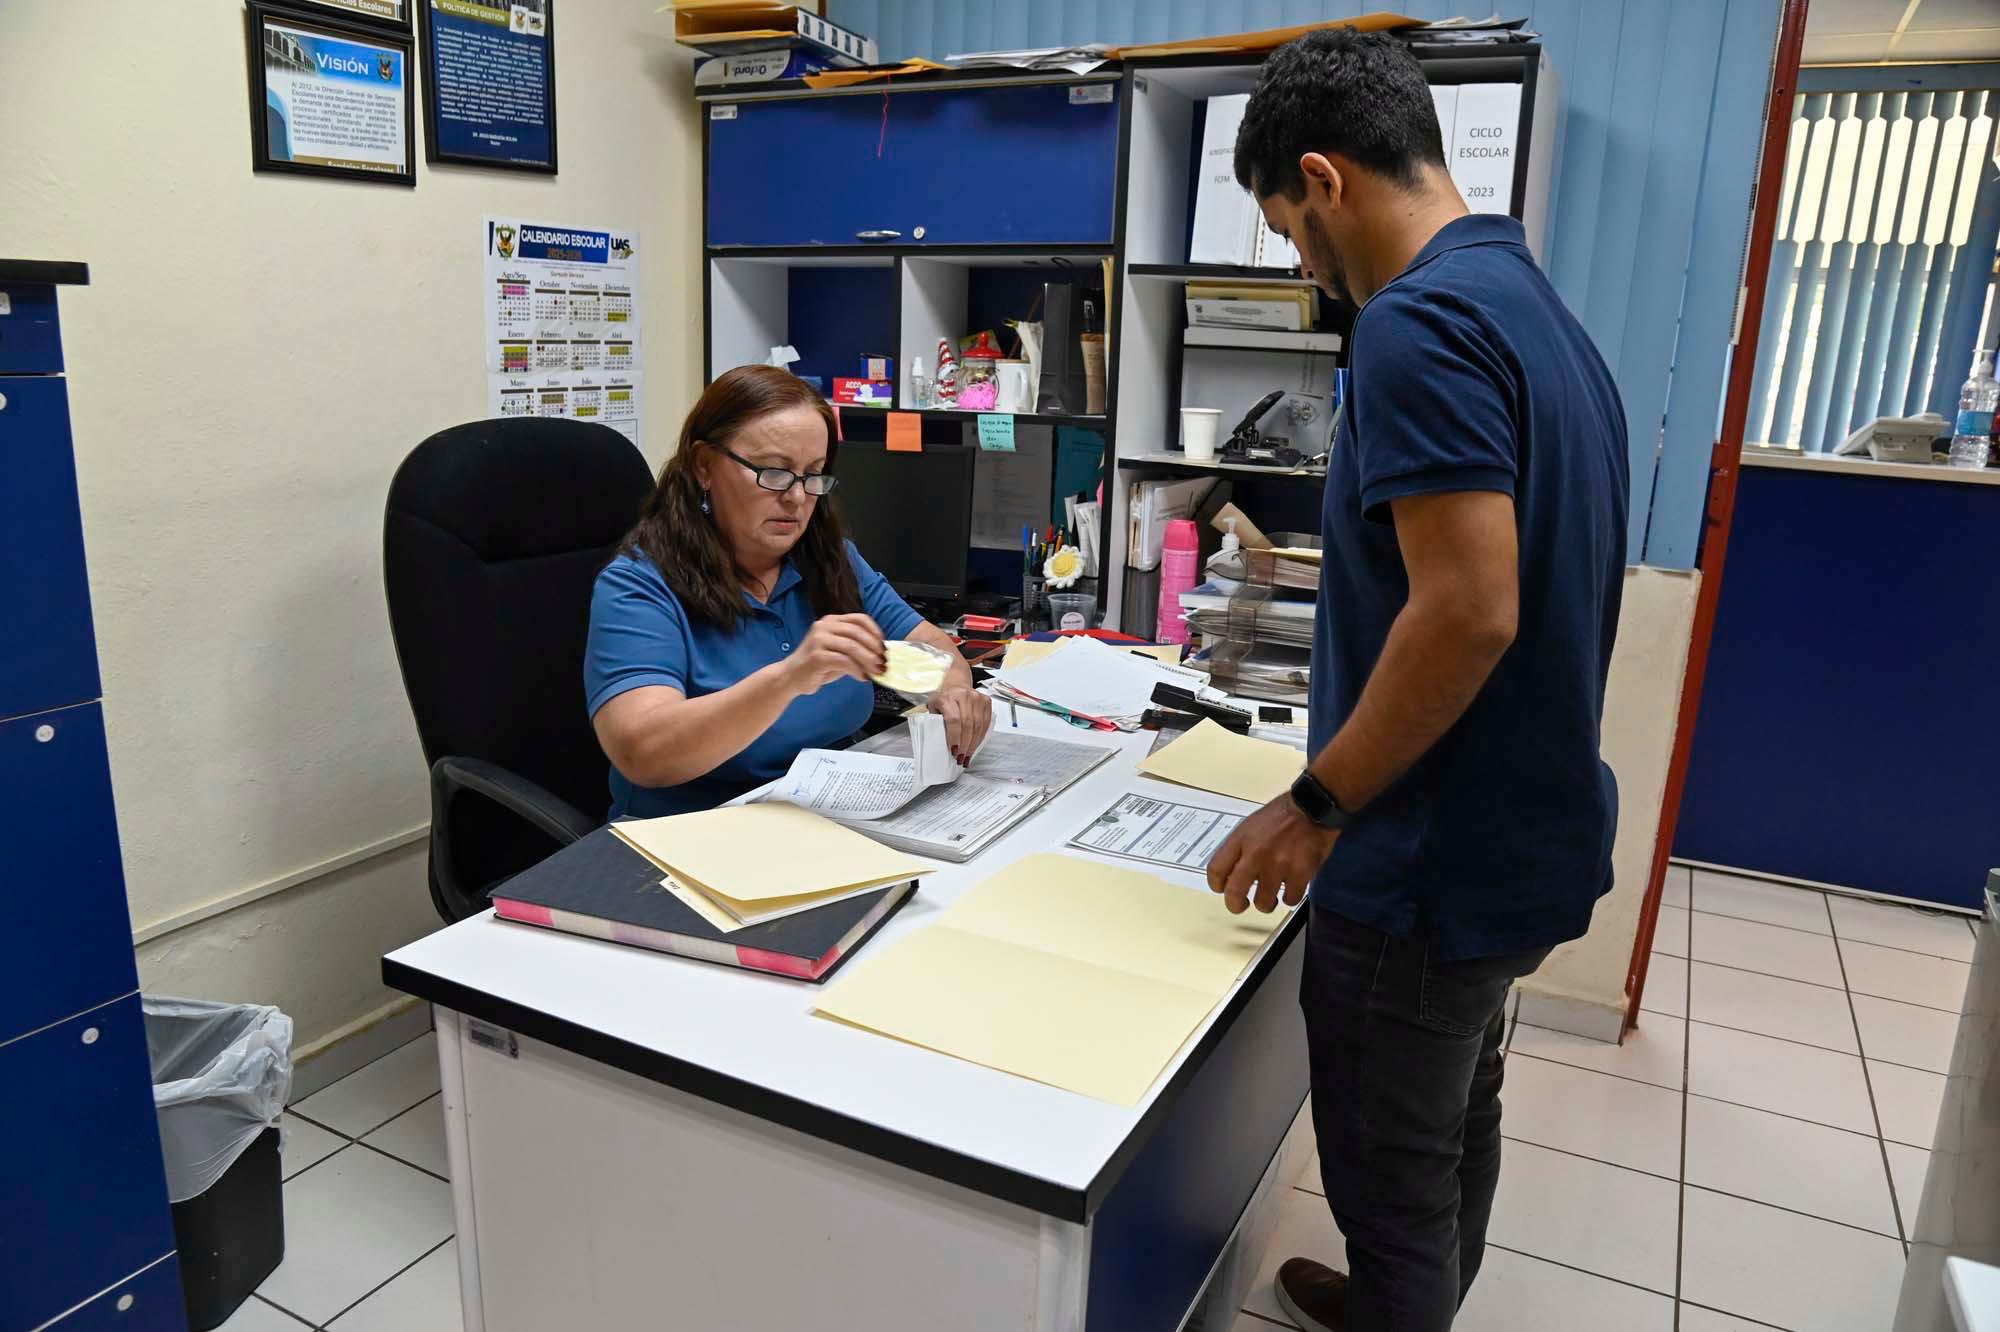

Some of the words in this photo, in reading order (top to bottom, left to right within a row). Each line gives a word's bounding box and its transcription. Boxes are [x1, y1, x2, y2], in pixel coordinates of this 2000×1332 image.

[316, 52, 368, 75] VISIÓN
[1469, 127, 1502, 138] CICLO
[1459, 147, 1509, 158] ESCOLAR
[1467, 187, 1495, 197] 2023
[521, 229, 570, 245] CALENDARIO
[571, 234, 606, 249] ESCOLAR
[611, 238, 630, 251] UAS
